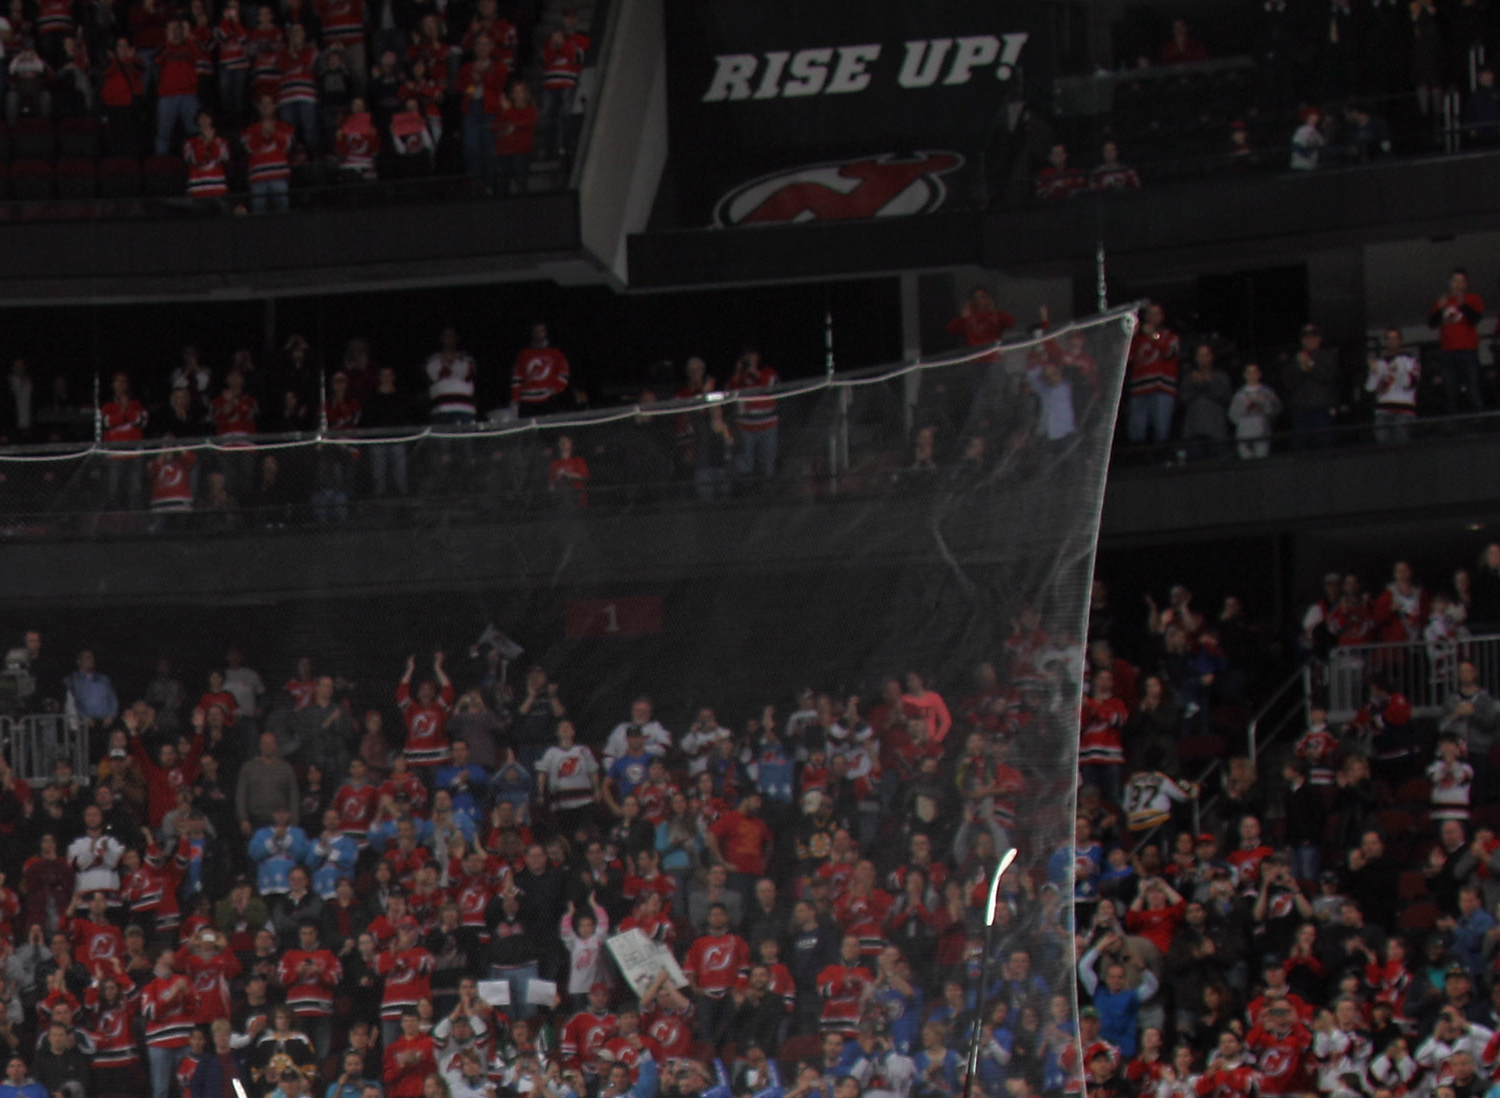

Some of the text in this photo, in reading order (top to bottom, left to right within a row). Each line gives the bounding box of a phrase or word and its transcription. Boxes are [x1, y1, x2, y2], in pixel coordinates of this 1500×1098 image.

[702, 32, 1030, 101] RISE UP!
[603, 604, 620, 632] 1
